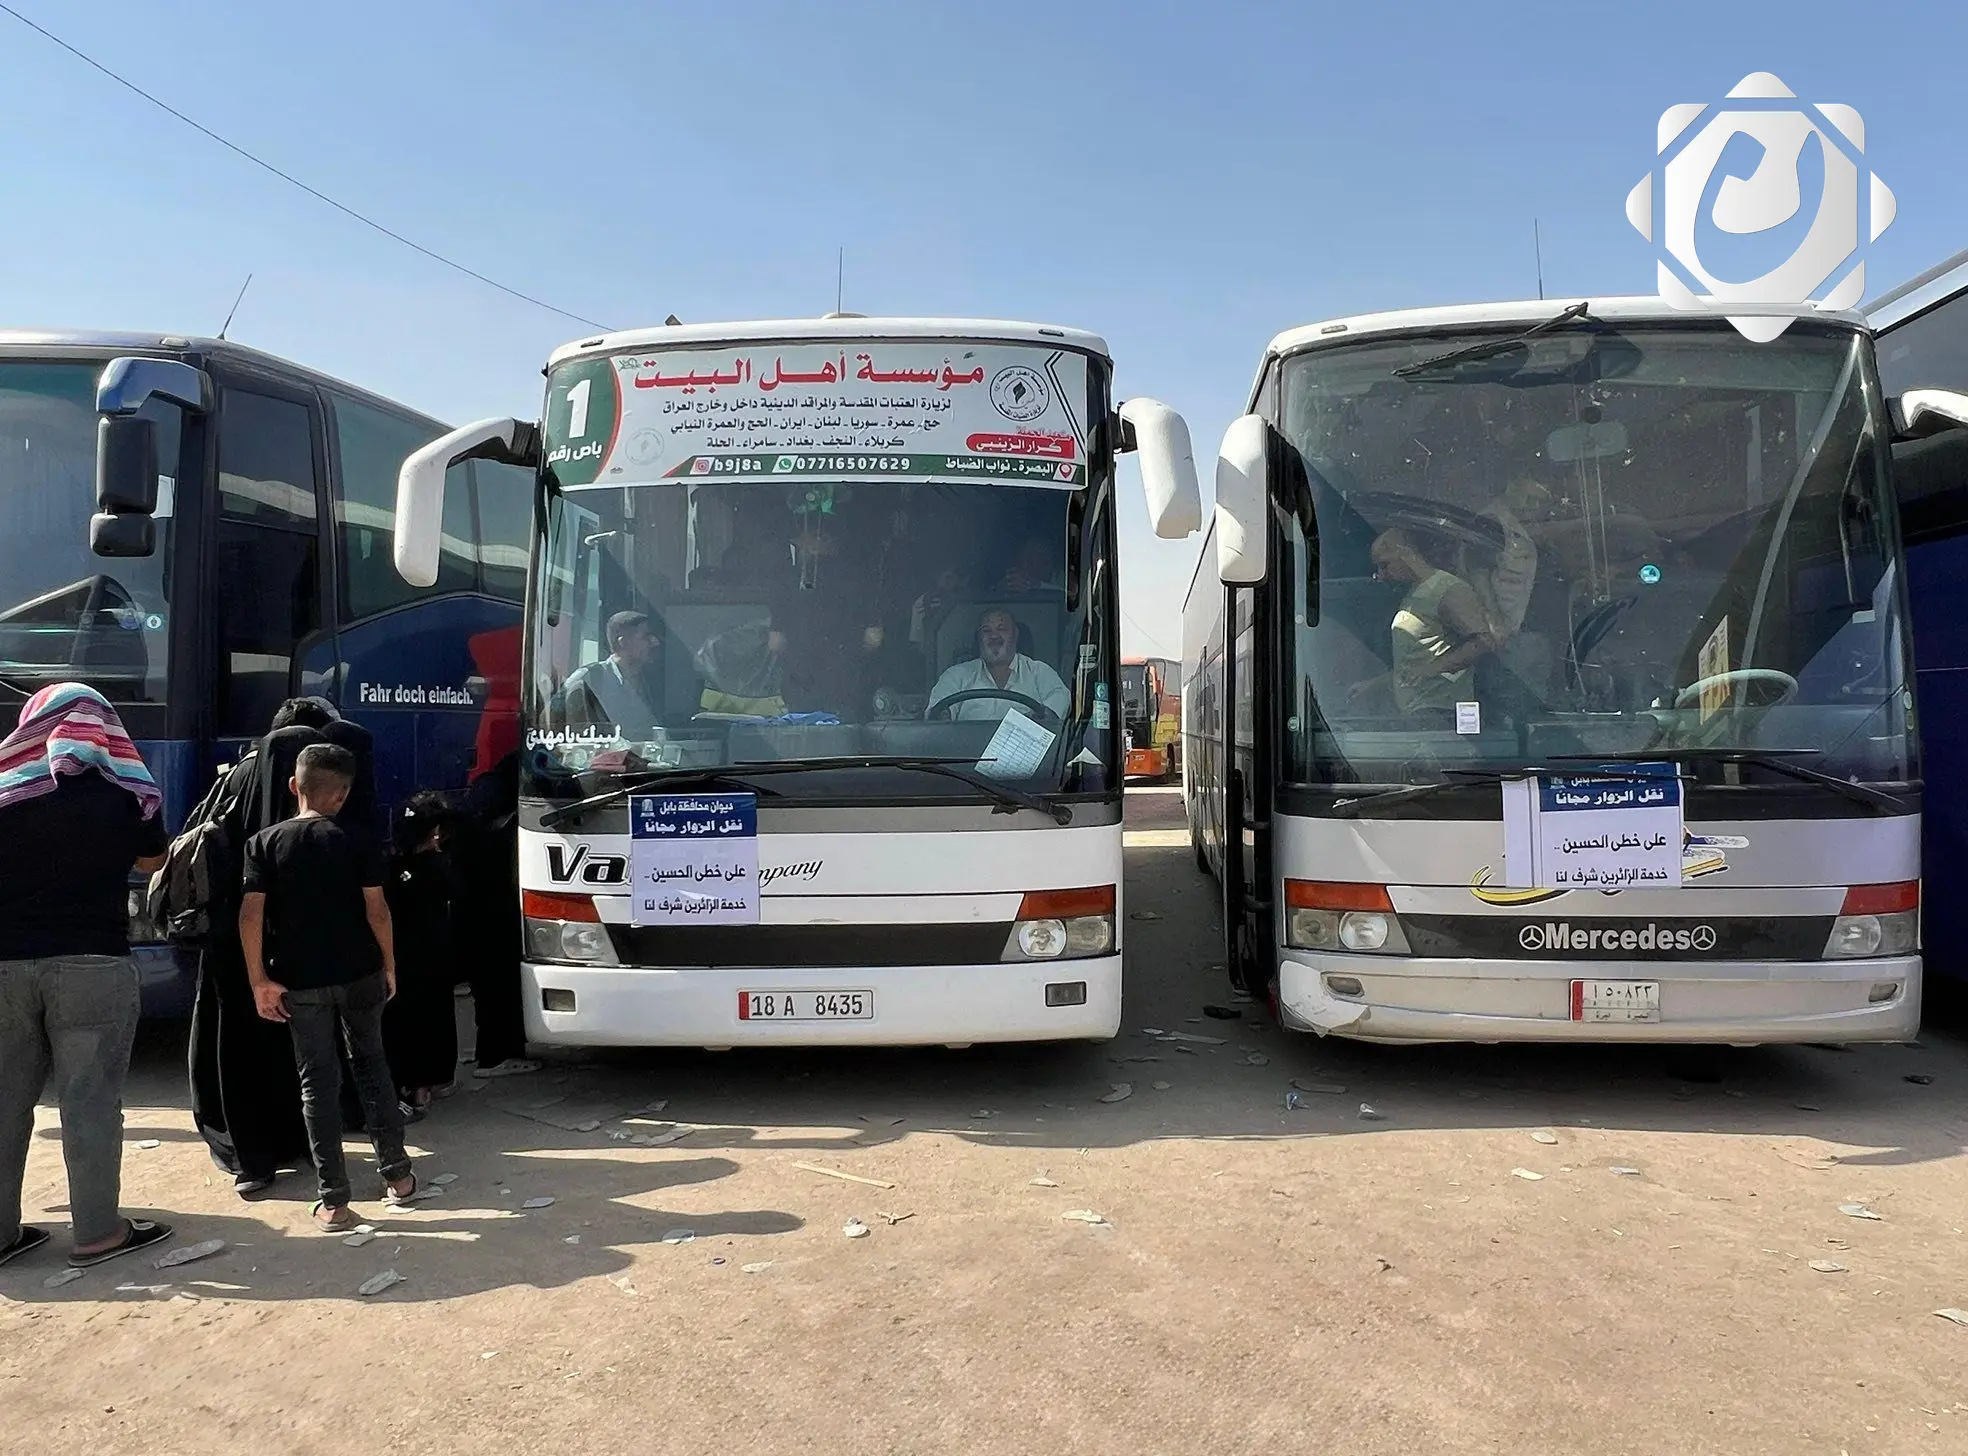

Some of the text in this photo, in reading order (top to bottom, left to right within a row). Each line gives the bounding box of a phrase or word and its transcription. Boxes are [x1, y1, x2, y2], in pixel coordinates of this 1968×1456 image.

[635, 350, 984, 393] مؤسسة أهل البيت
[566, 379, 591, 439] 1
[663, 396, 951, 414] لزيارة العتبات المقدسة والمراقد الدينية داخل وخارج العراق
[707, 418, 745, 431] والعمرة
[748, 417, 772, 431] الحج
[780, 417, 805, 429] ايران
[815, 416, 841, 429] لبنان
[851, 417, 878, 430] سوريا
[887, 416, 915, 429] عمرة
[923, 420, 940, 431] حج
[572, 440, 602, 460] باص
[707, 437, 734, 448] الحلة
[742, 437, 777, 449] سامراء
[786, 436, 814, 449] بغداد
[822, 436, 856, 449] النجف
[864, 436, 904, 449] كربلاء
[546, 444, 571, 468] رقم
[796, 457, 911, 471] 07716507629
[945, 456, 984, 470] الضباط
[1019, 460, 1054, 476] البصرة
[360, 682, 474, 705] Fahr doch einfach.
[1594, 789, 1634, 805] الزوار
[1638, 788, 1664, 803] نقل
[660, 798, 734, 815] ديوان محافظة بابل
[680, 820, 715, 834] الزوار
[719, 819, 743, 833] نقل
[1562, 834, 1608, 854] الحسين
[1611, 833, 1641, 851] خطى
[1643, 833, 1667, 850] على
[544, 843, 632, 886] Va
[695, 864, 722, 881] خطى
[725, 864, 746, 881] على
[652, 864, 693, 882] الحسين
[1555, 867, 1668, 886] خدمة الزائرين شرف لنا
[644, 896, 746, 914] خدمة الزائرين شرف لنا
[1545, 923, 1691, 950] Mercedes
[751, 994, 863, 1016] 18 A 8435
